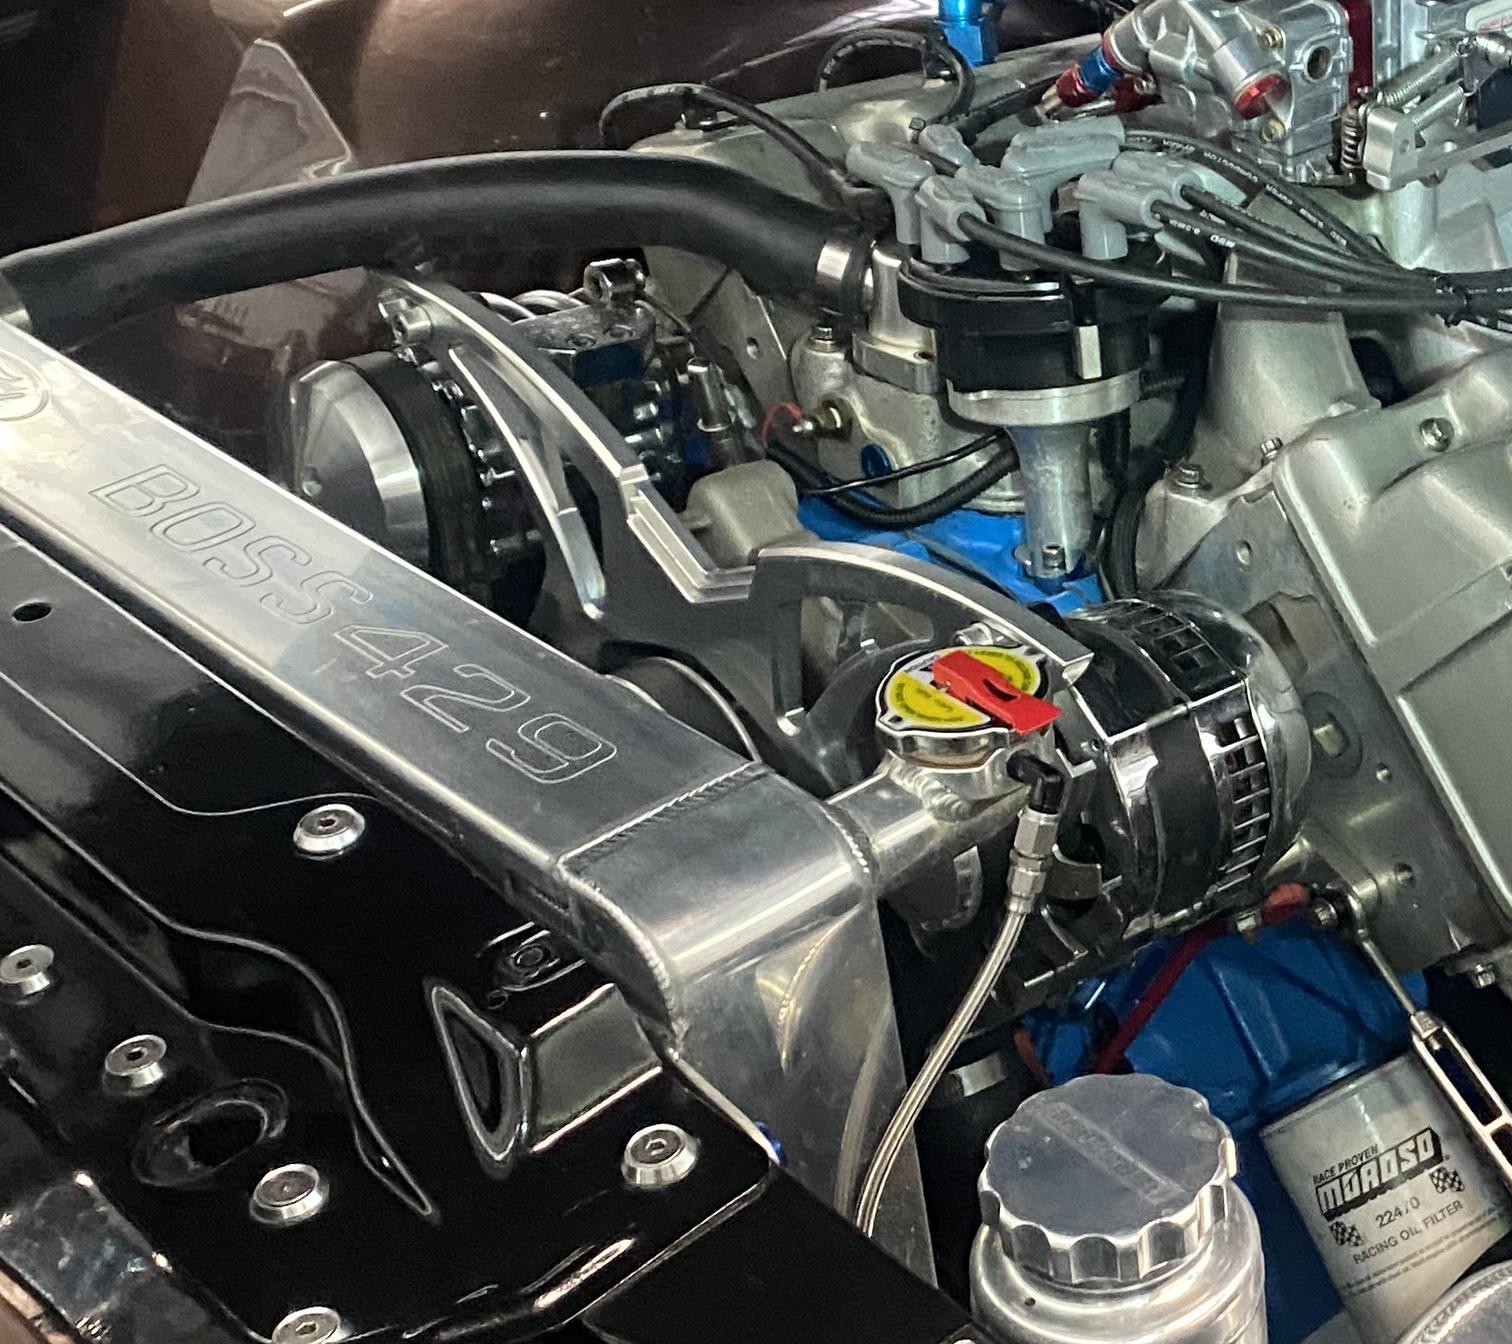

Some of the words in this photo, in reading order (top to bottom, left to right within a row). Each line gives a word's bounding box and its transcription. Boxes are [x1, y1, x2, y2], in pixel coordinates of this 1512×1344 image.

[88, 463, 374, 625] BOSS
[332, 623, 618, 785] 429
[1312, 1166, 1337, 1185] RACE
[1317, 1128, 1441, 1216] MOROSO
[1352, 1236, 1398, 1265] RACING
[1400, 1223, 1421, 1242] OIL
[1422, 1199, 1464, 1226] FILTER
